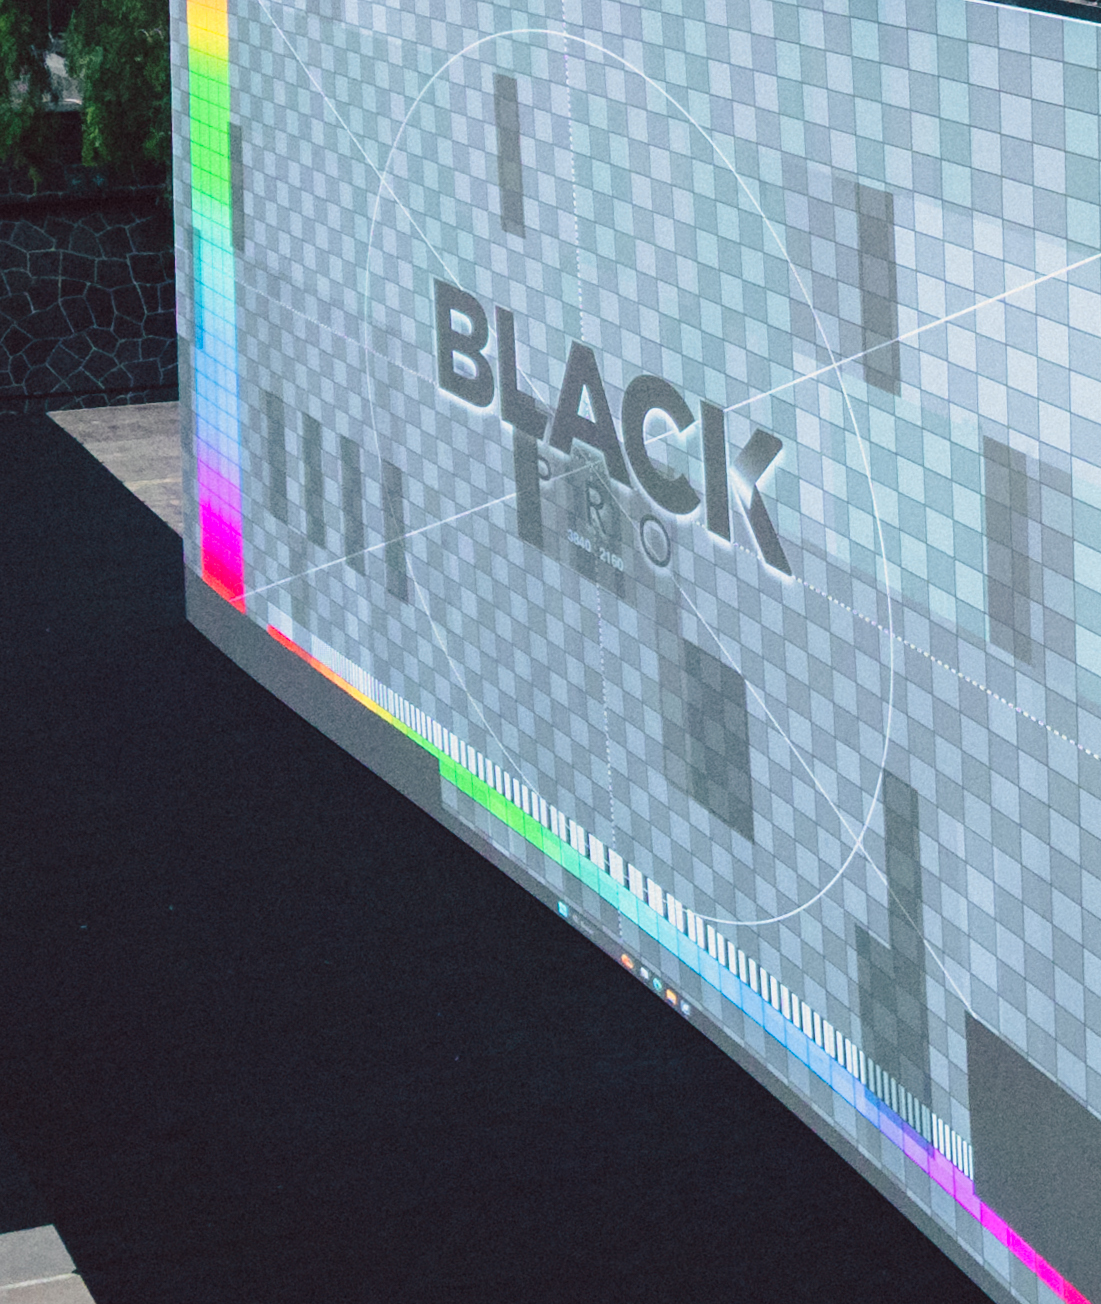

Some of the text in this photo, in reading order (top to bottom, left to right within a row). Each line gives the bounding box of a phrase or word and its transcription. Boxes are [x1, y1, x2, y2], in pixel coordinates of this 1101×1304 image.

[433, 277, 793, 577] BLACK
[567, 528, 625, 572] 3840 2160
